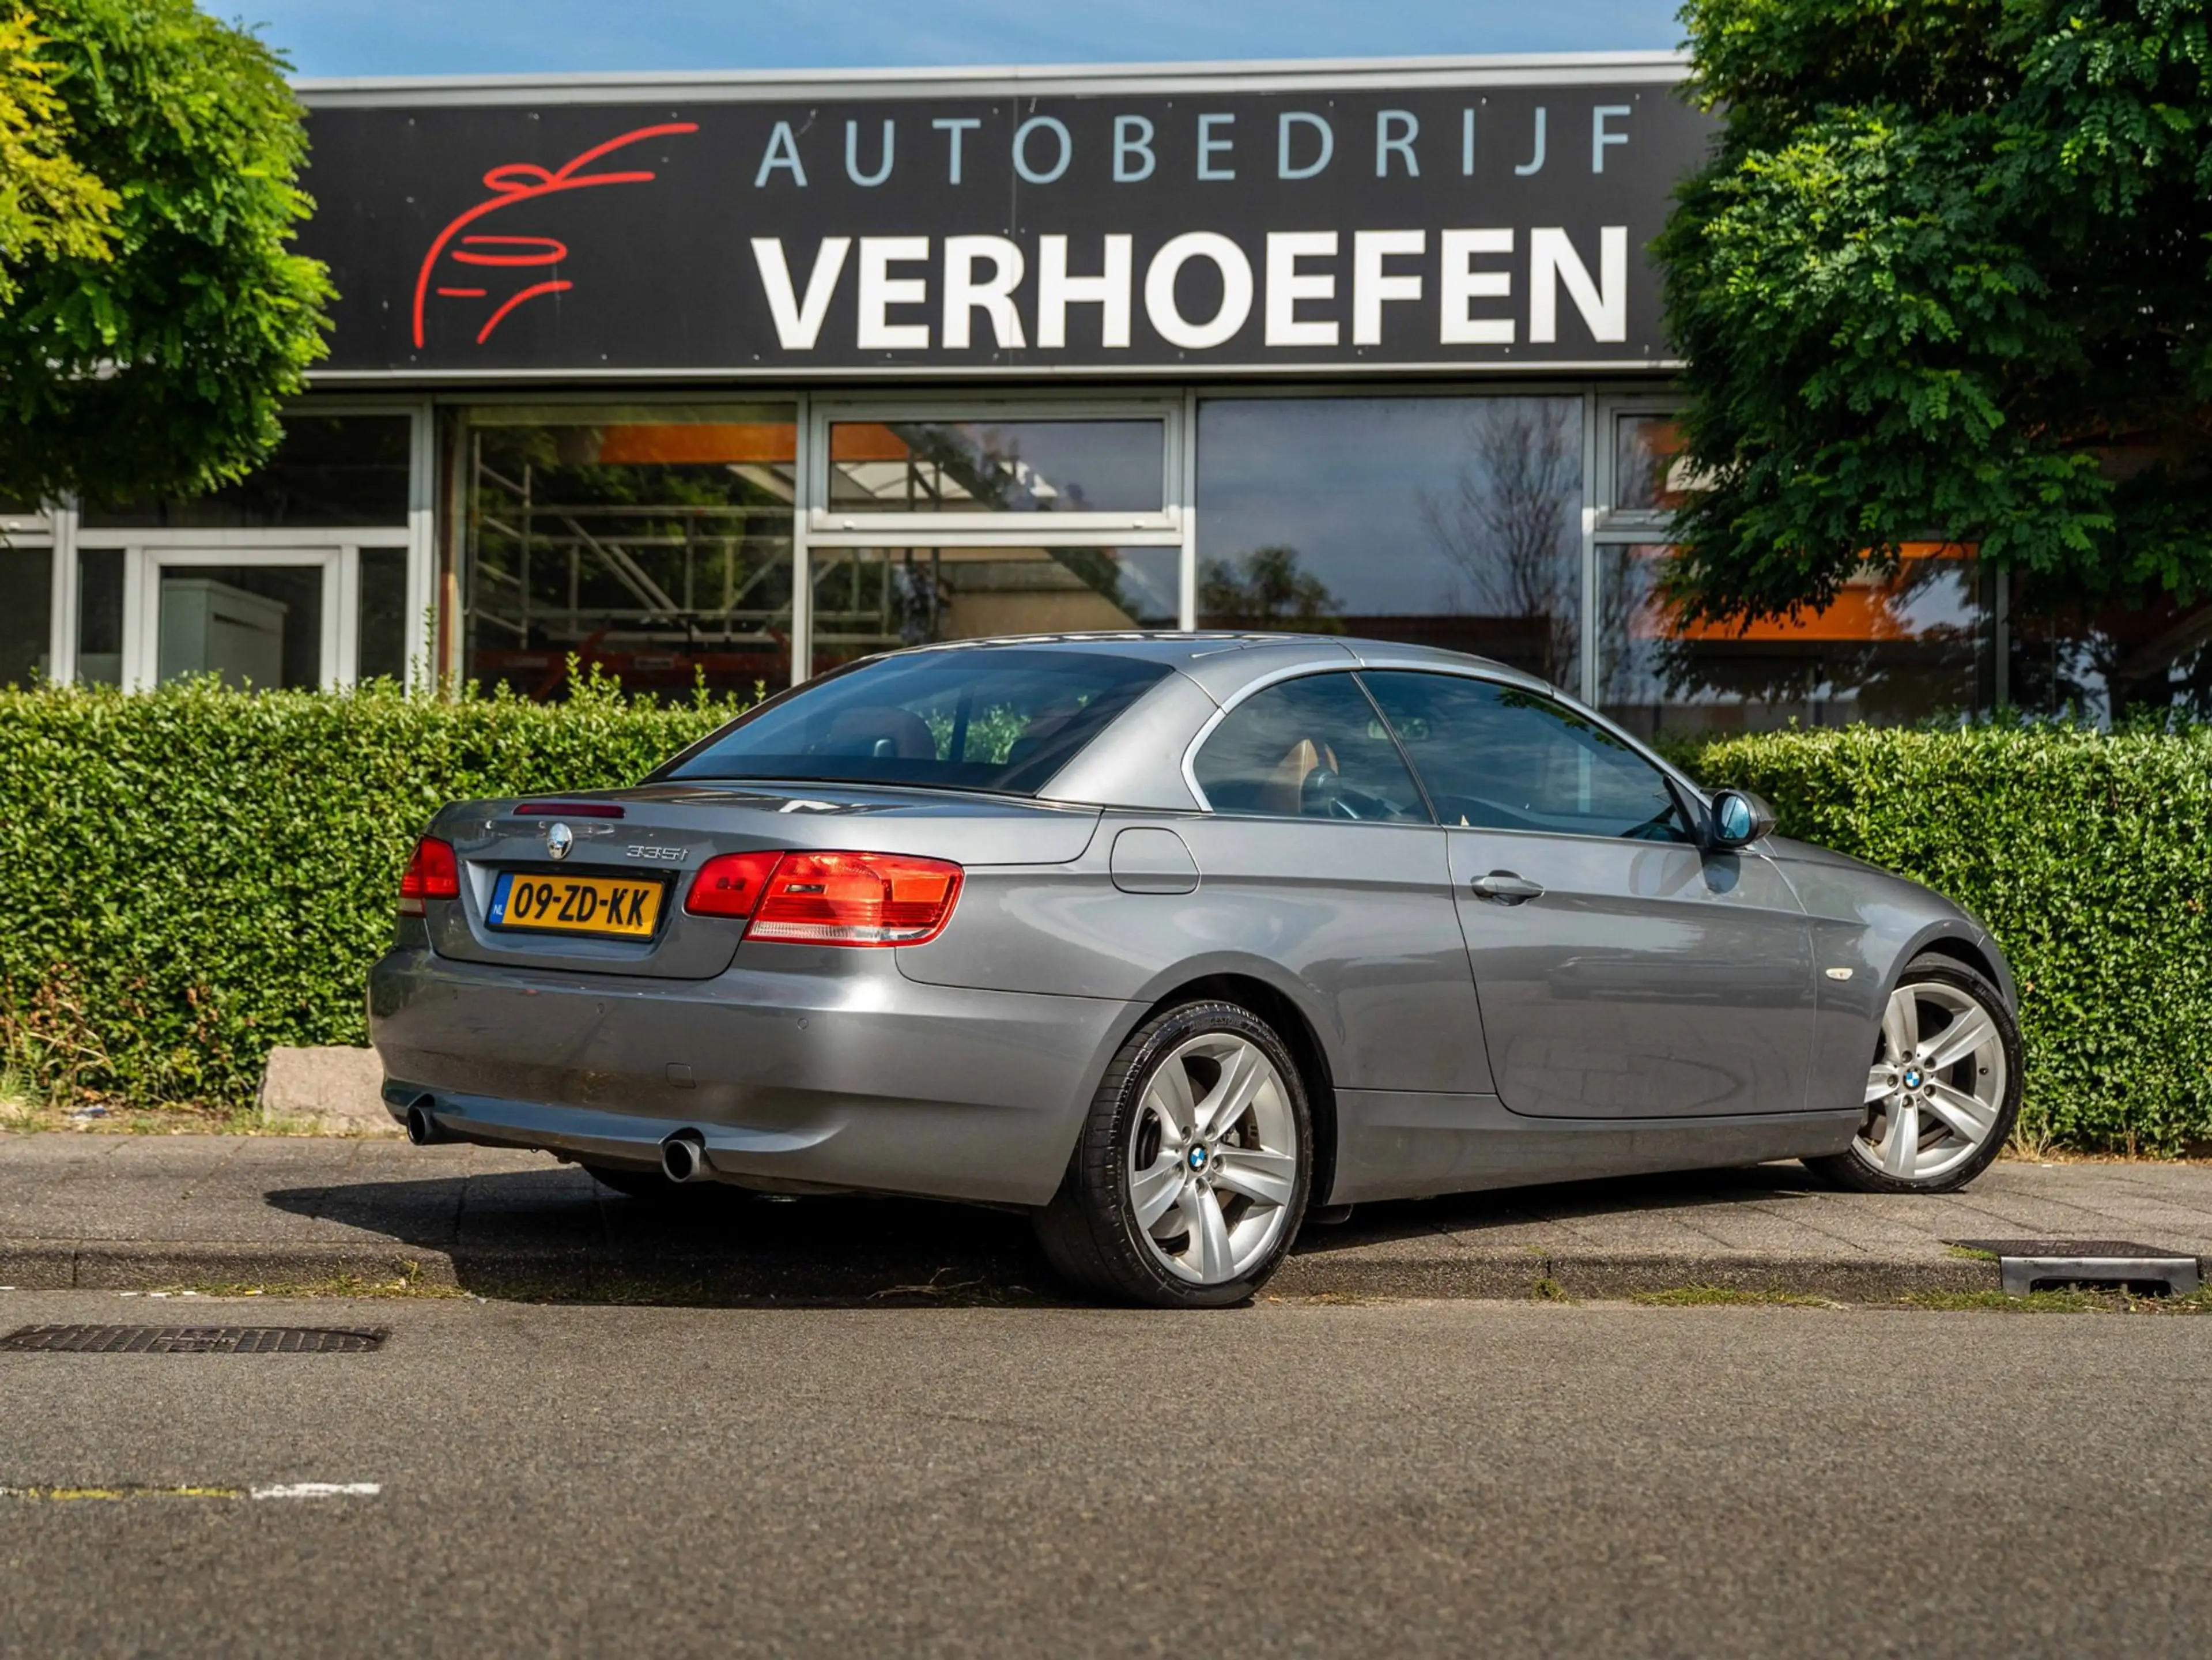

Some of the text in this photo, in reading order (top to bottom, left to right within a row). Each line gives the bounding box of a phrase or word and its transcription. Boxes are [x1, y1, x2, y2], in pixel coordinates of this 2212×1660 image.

[754, 105, 1632, 188] AUTOBEDRIJF
[750, 225, 1628, 350] VERHOEFEN
[626, 844, 688, 861] 335i
[493, 904, 503, 915] NL
[514, 882, 650, 926] 09-ZD-KK
